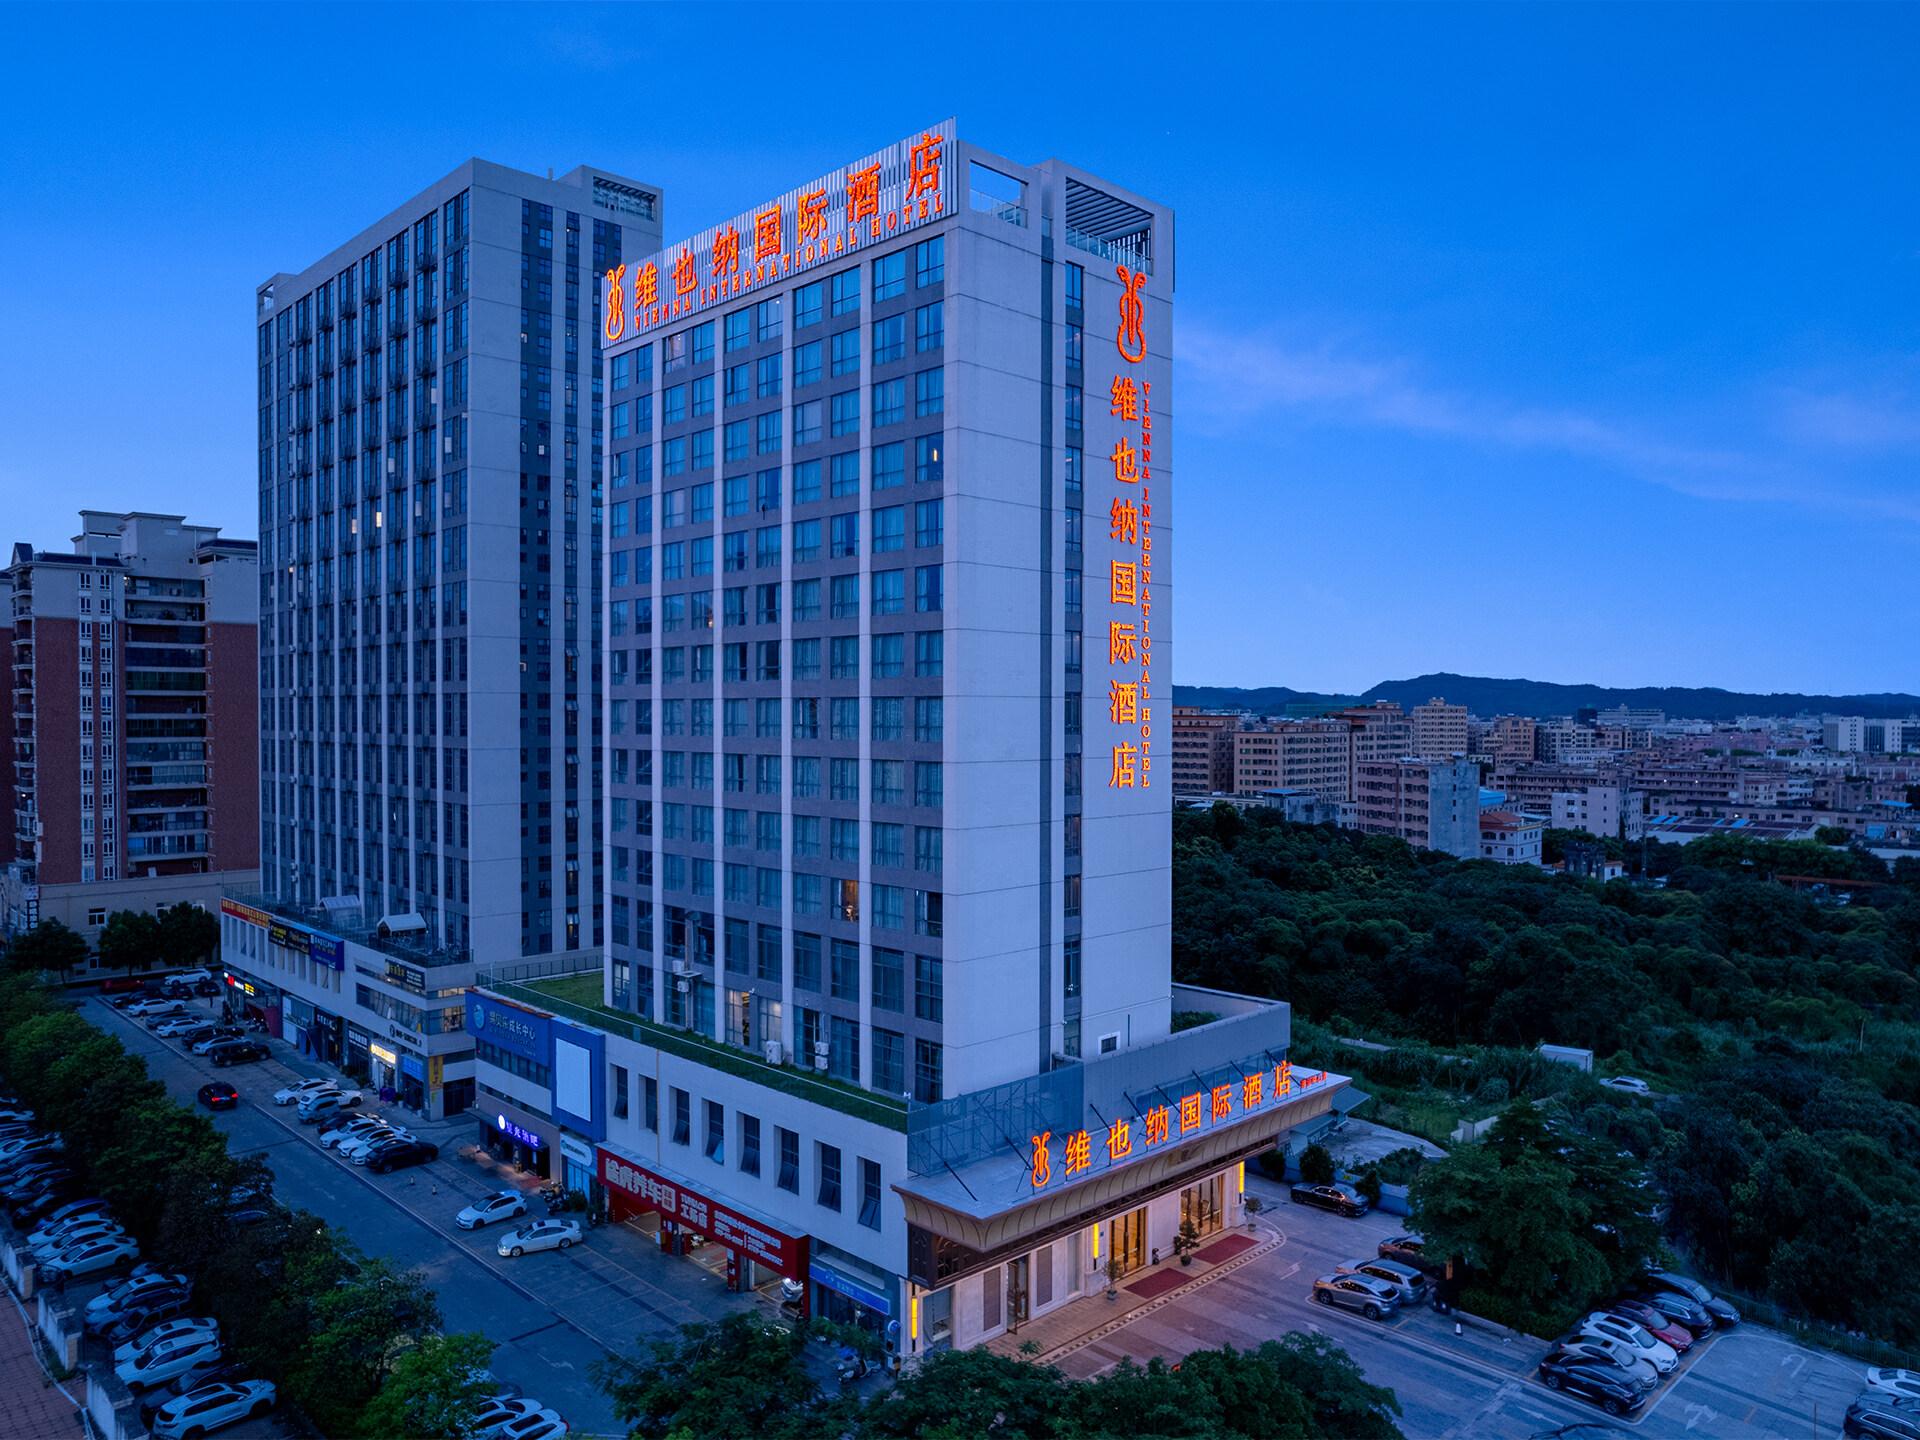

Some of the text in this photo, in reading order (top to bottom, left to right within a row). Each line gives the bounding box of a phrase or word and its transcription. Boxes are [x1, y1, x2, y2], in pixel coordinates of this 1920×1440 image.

[634, 133, 944, 311] 维也纳国际酒店
[634, 192, 943, 331] VIENNA INTERNATIONAL HOTEL
[1109, 374, 1140, 789] 维也纳国际酒店
[1141, 381, 1152, 788] VIENNA INTERNATIONAL HOTEL
[1065, 1060, 1293, 1176] 维也纳国际酒店
